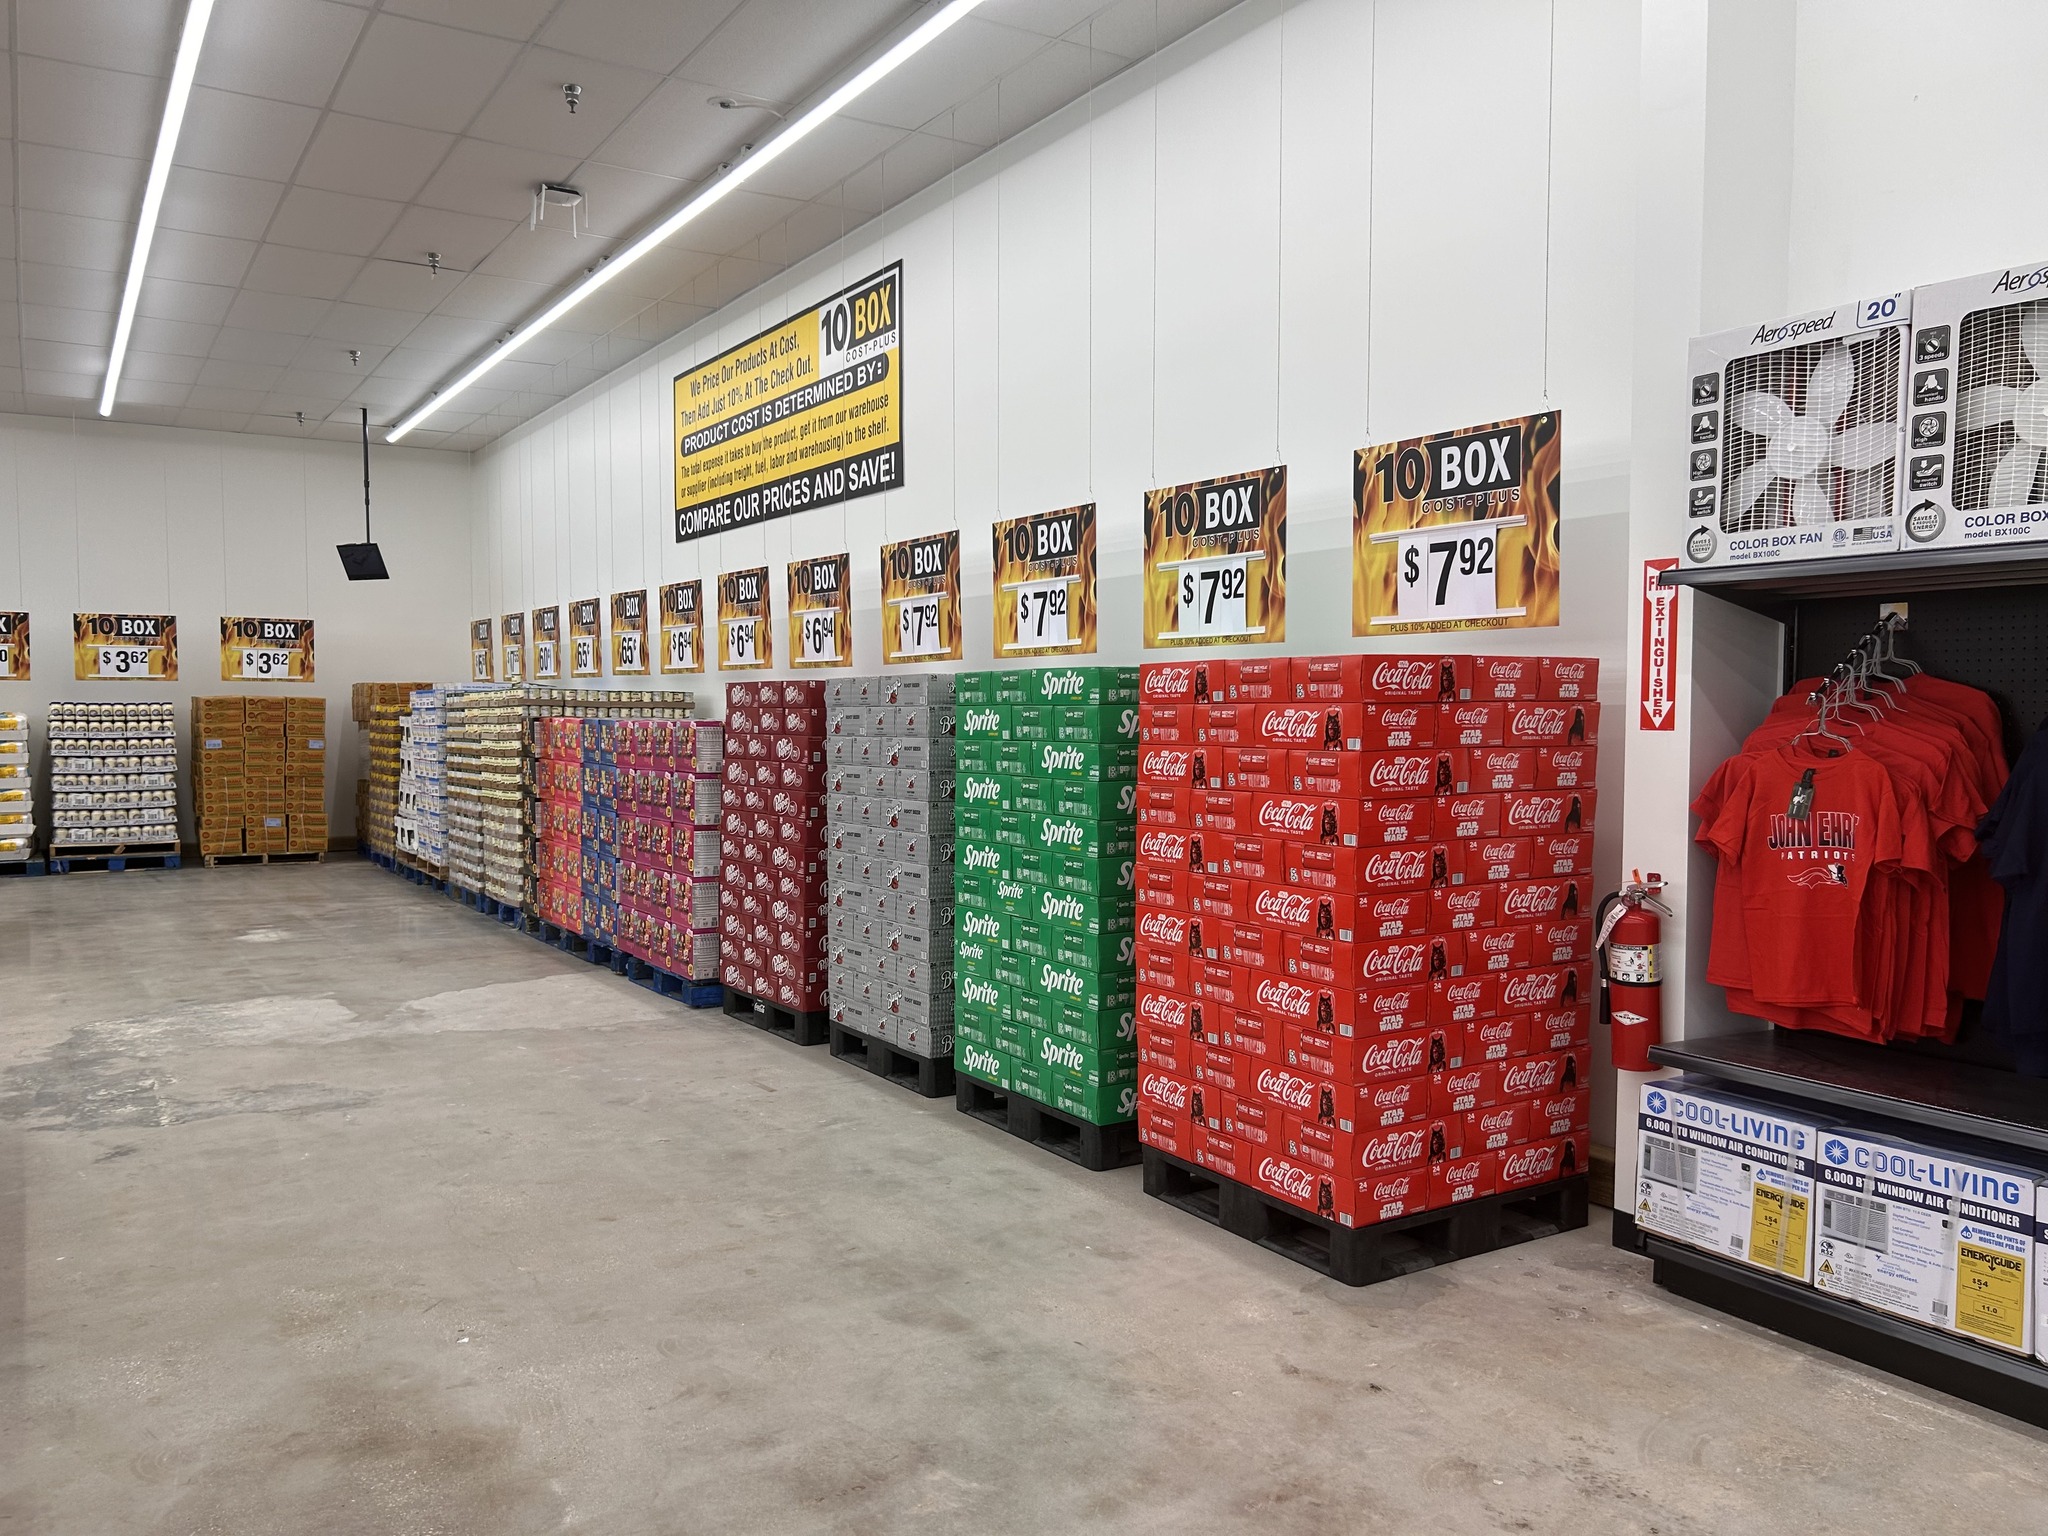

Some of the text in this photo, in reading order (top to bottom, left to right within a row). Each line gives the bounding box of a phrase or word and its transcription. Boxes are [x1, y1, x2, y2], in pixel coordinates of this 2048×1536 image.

[822, 284, 891, 356] 10 BOX
[1751, 311, 1836, 346] Aerospeed
[846, 332, 896, 362] COST-PLUS
[690, 331, 800, 397] We Price Our Products At Cost,
[681, 355, 813, 427] Then Add Just 10% At The Check Out.
[685, 361, 882, 453] PRODUCT COST IS DETERMINED BY:
[682, 394, 888, 479] The total expense it takes to buy the product, get it from our warehouse
[681, 417, 889, 497] or supplier (including freight, fuel, labor and warehousing) to the shelf.
[1375, 436, 1512, 504] 10 BOX
[679, 451, 895, 535] COMPARE OUR PRICES AND SAVE!
[1422, 489, 1520, 514] COST-PLUS
[1160, 485, 1253, 538] 10 BOX
[1965, 511, 2048, 527] COLOR BOX
[1004, 519, 1072, 564] 10 BOX
[1192, 529, 1260, 547] COST-PLUS
[1730, 533, 1822, 550] COLOR BOX FAN
[1873, 530, 1892, 539] USA
[1965, 527, 2030, 538] model BX100C
[889, 543, 942, 580] 10 BOX
[1730, 550, 1780, 560] model BX100C
[723, 577, 758, 603] 10 BOX
[795, 564, 836, 594] 10 BOX
[582, 605, 594, 622] BOX
[616, 596, 639, 619] 10 BOX
[665, 588, 694, 612] 10 BOX
[88, 618, 156, 635] 10 BOX
[233, 622, 296, 638] 10 BOX
[1390, 618, 1508, 632] PLUS 10% ADDED AT CHECKOUT
[1653, 597, 1665, 717] EXTINGUISHER
[1041, 670, 1084, 700] Sprite
[1372, 661, 1435, 690] Coca-Cola
[1494, 690, 1516, 698] WARS
[964, 708, 1000, 736] Sprite
[1262, 710, 1321, 738] Coca-Cola
[1512, 708, 1566, 735] Coca-Cola
[1041, 745, 1084, 774] Sprite
[1370, 757, 1433, 787] Coca-Cola
[1767, 812, 1812, 850] JOHN
[1671, 1097, 1805, 1150] COOL-LIVING
[1646, 1117, 1805, 1172] 6,000 TU WINDOW AIR CONDITIOER
[1854, 1147, 2020, 1205] COOL-LIVING
[1824, 1169, 1853, 1186] 6,000
[1878, 1181, 1923, 1204] WINDOW
[1926, 1192, 1944, 1209] AIR
[1946, 1199, 2020, 1228] CNDITIONER
[1972, 1227, 1996, 1238] REMOVES
[2004, 1235, 2019, 1244] PINTS
[1978, 1236, 2004, 1249] MOISTURE
[1961, 1247, 2022, 1272] ENERGYGUIDE
[1972, 1278, 1988, 1288] $54
[1982, 1305, 1998, 1314] 11.0
